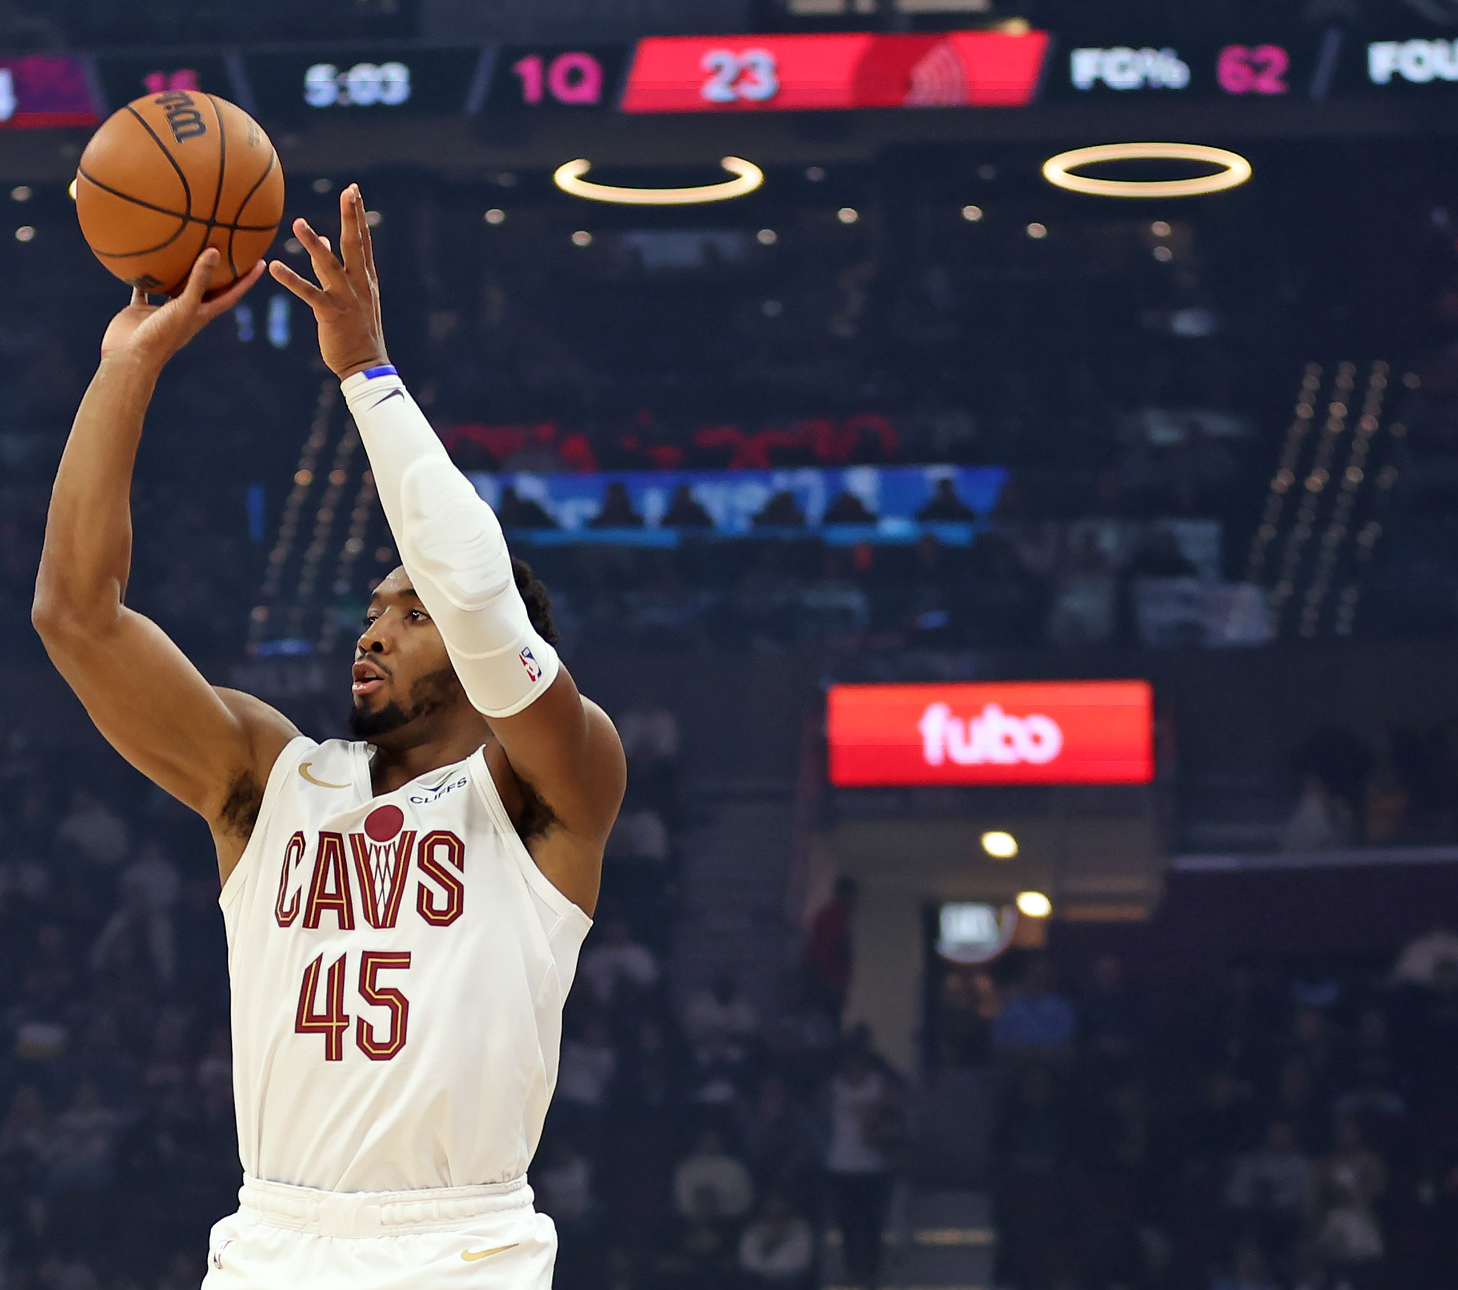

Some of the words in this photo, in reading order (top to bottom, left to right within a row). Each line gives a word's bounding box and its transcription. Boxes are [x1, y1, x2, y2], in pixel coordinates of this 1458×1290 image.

[304, 62, 410, 106] 5:03
[513, 52, 604, 104] 1Q
[699, 48, 778, 102] 23
[1070, 47, 1191, 89] FG%
[1217, 44, 1289, 94] 62
[918, 702, 1063, 766] fubo
[409, 777, 467, 804] CLIFFS
[275, 830, 465, 930] CAVS
[295, 951, 411, 1061] 45
